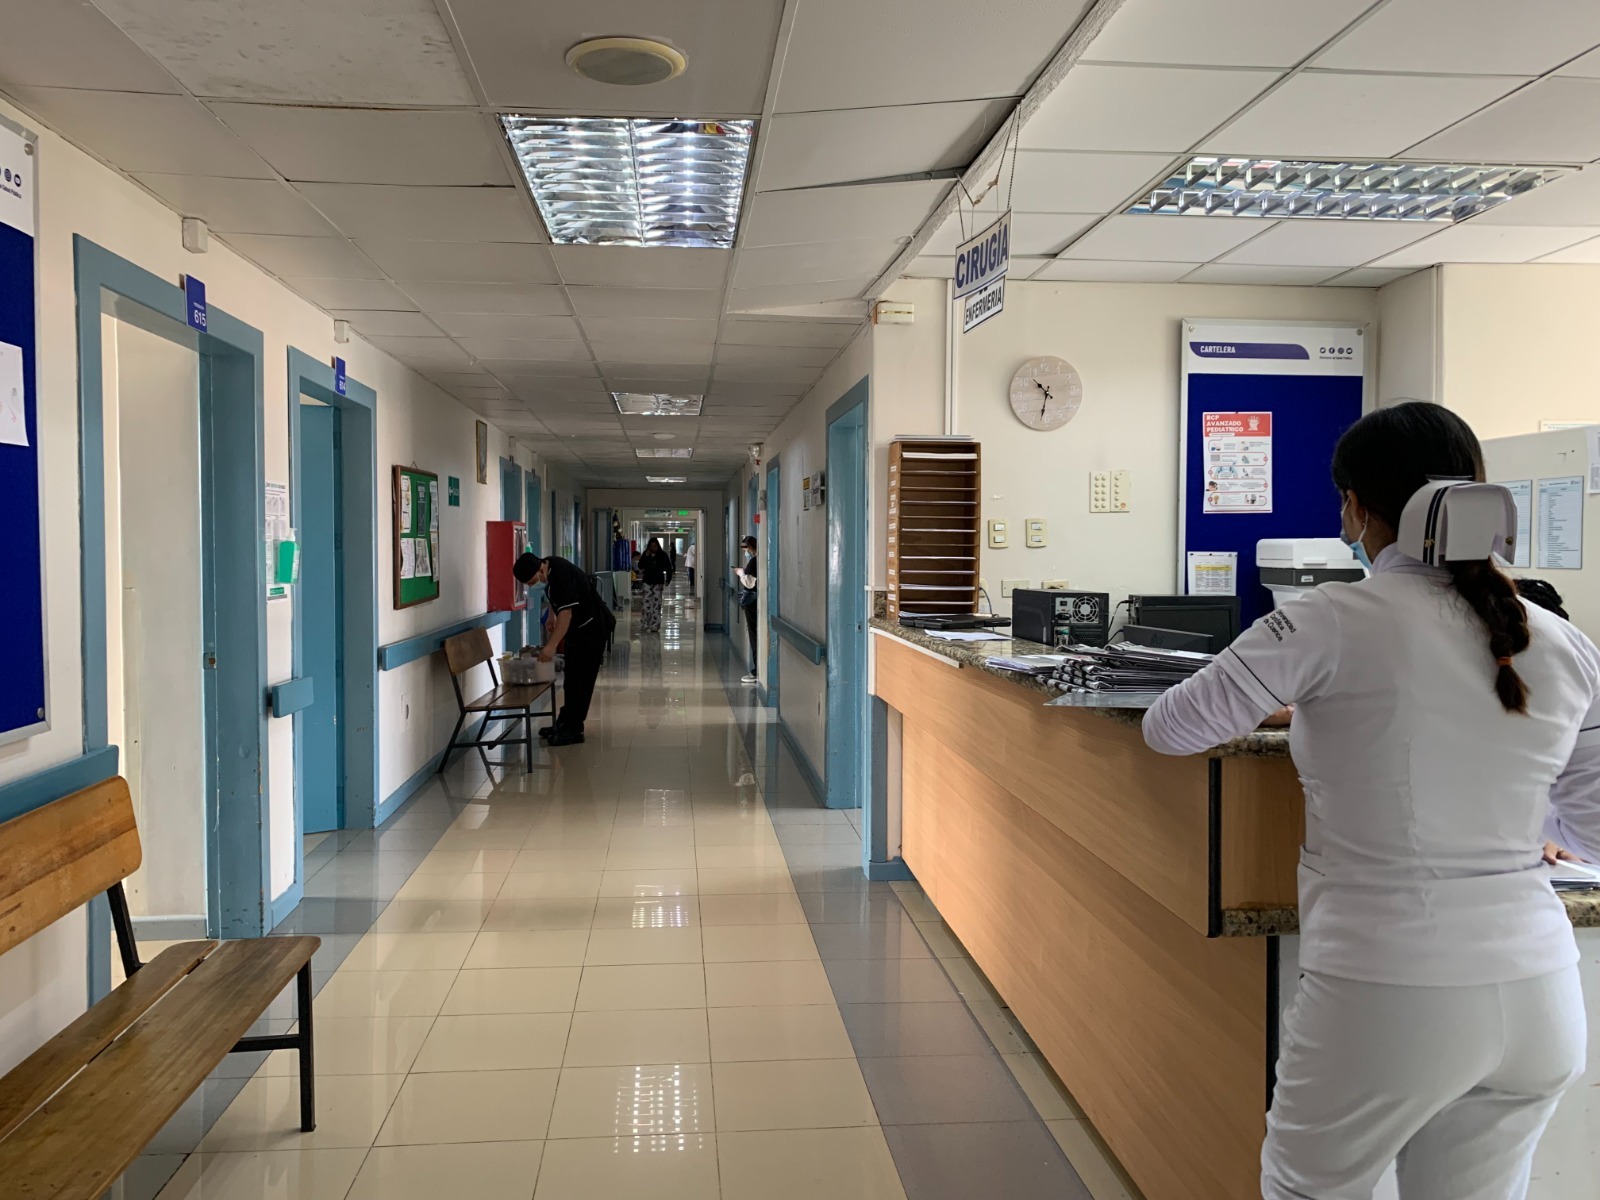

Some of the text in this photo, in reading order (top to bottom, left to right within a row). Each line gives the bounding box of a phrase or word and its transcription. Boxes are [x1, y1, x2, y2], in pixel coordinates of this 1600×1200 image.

[956, 221, 1008, 289] CIRUGÍA
[965, 286, 1002, 326] ENFERMERIA
[194, 309, 207, 327] 615
[1200, 345, 1236, 354] CARTELERA
[1029, 367, 1038, 377] 11
[1040, 363, 1050, 373] 12
[1020, 378, 1030, 387] 10
[1043, 414, 1050, 424] 6
